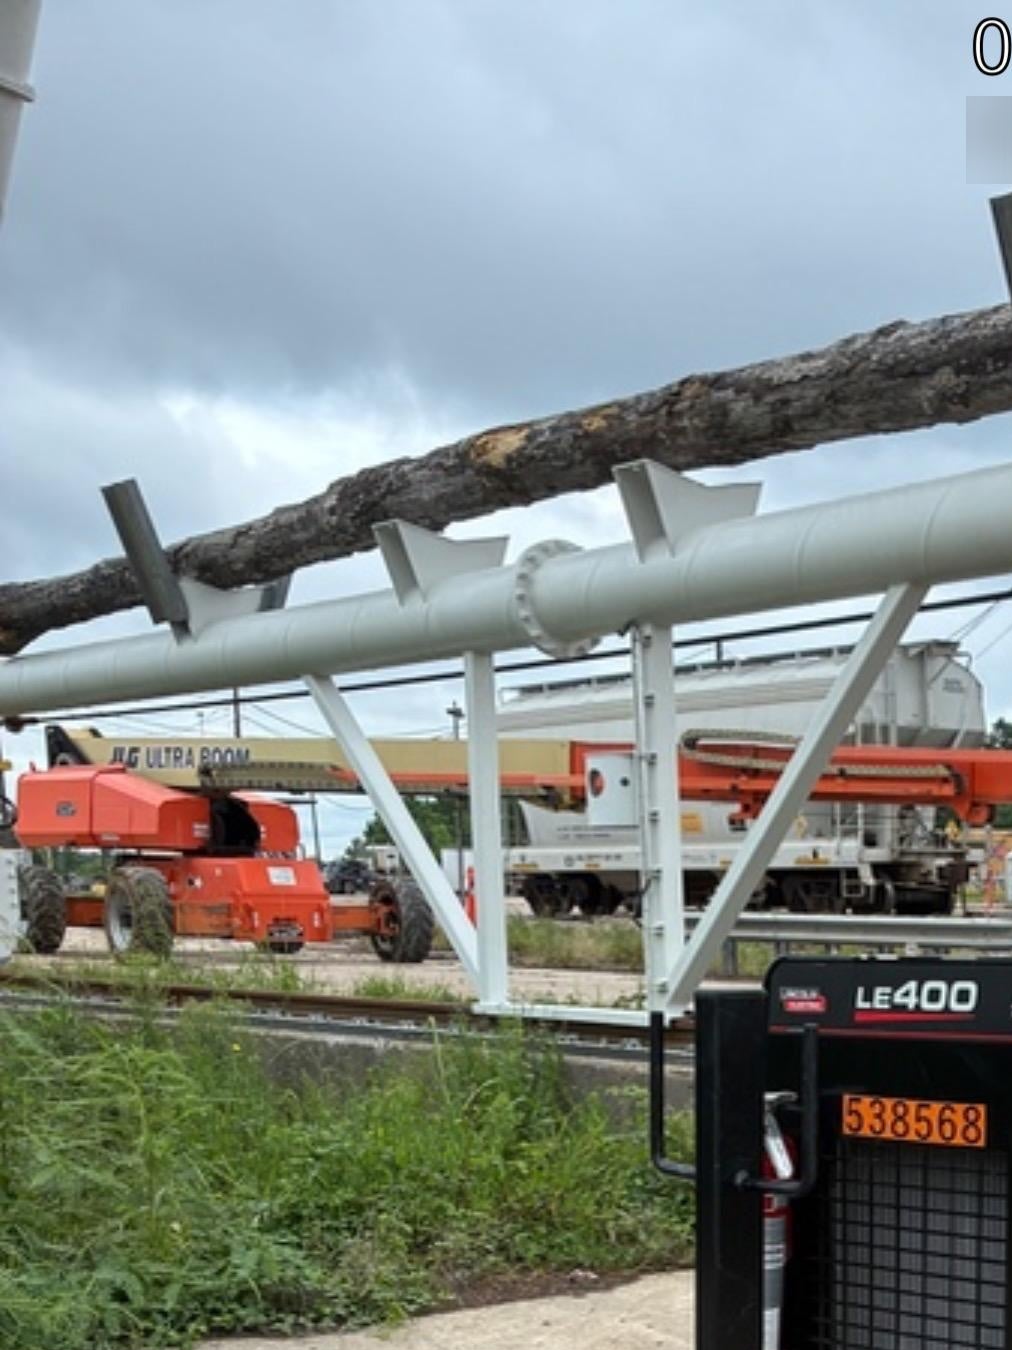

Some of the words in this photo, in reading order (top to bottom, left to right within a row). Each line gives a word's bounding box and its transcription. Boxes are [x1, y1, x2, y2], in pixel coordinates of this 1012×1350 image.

[146, 746, 195, 769] ULTRA
[200, 746, 250, 768] BOOM
[854, 979, 979, 1013] LE400
[844, 1096, 985, 1145] 538568
